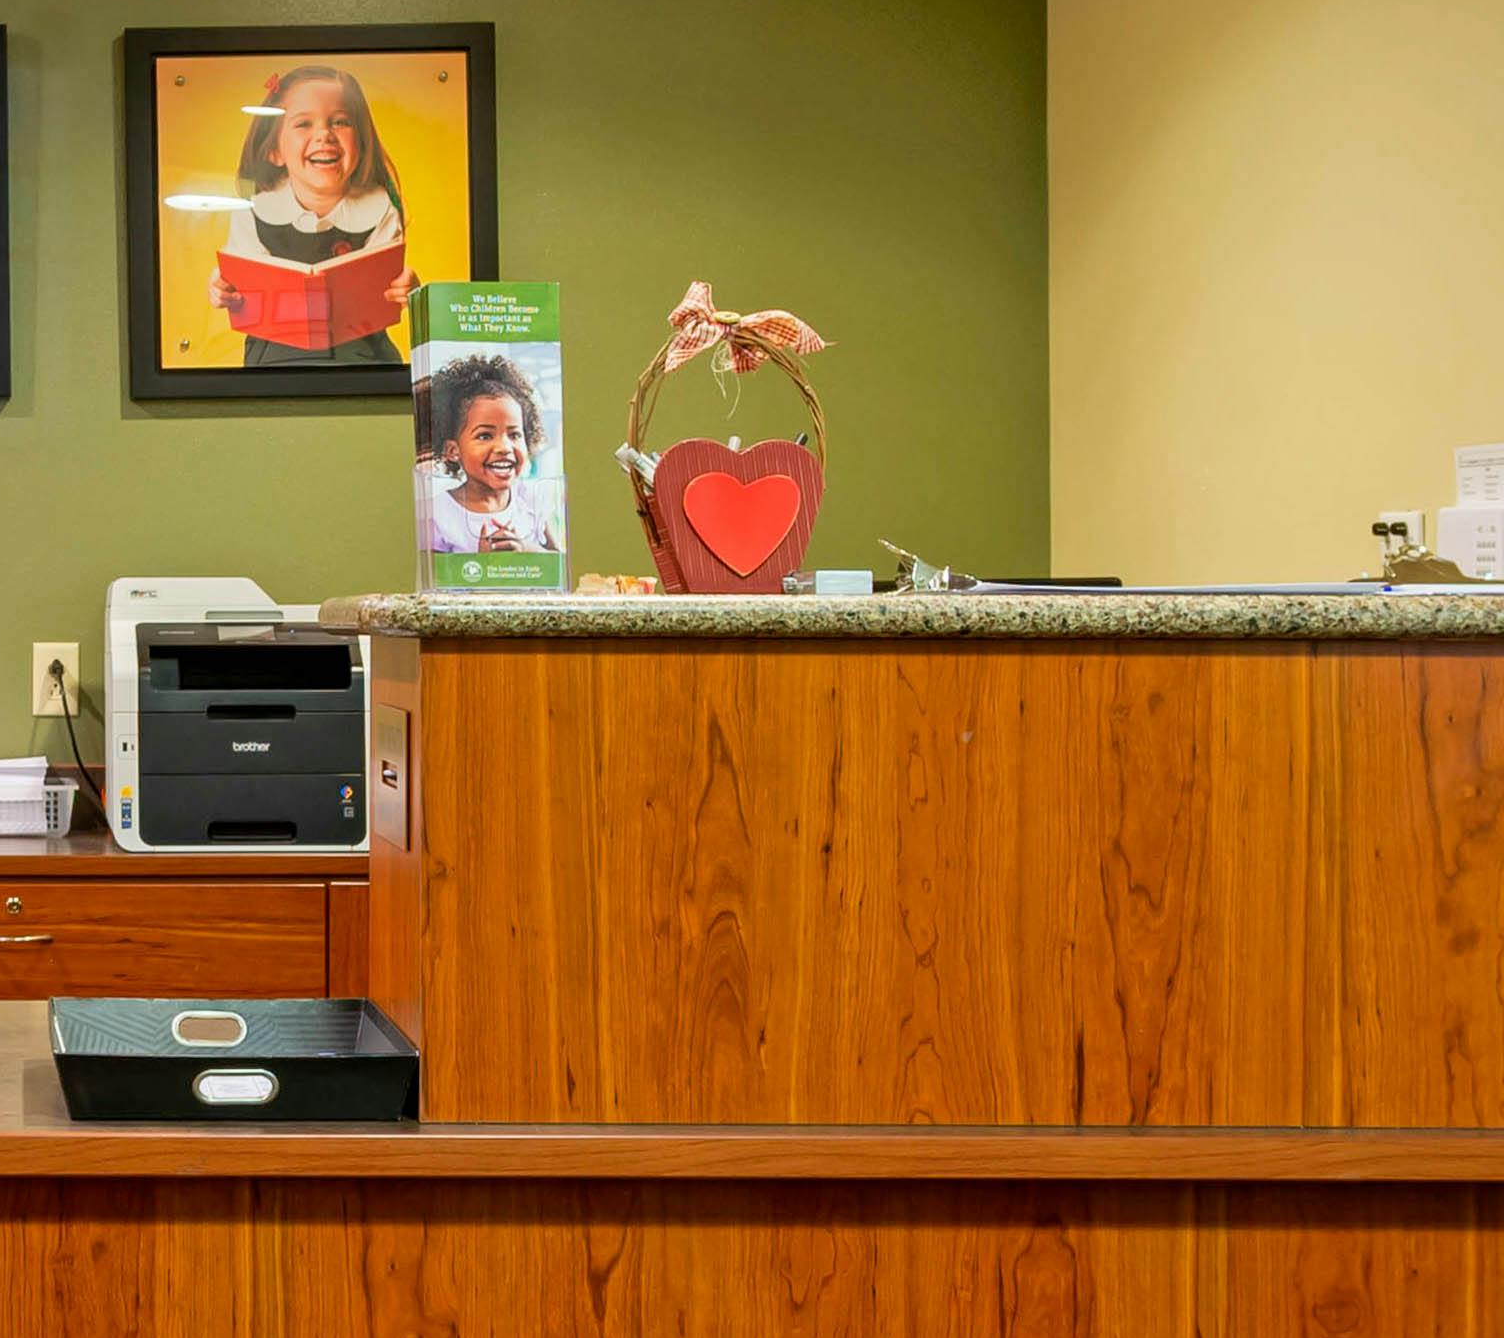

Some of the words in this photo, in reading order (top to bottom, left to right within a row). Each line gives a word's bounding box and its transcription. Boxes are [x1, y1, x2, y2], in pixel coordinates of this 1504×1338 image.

[472, 294, 485, 304] We
[487, 294, 517, 304] Believe
[450, 303, 469, 313] Who
[471, 303, 506, 313] Children
[508, 304, 539, 314] Become
[479, 313, 520, 324] Important
[460, 323, 482, 333] What
[484, 323, 504, 334] They
[232, 741, 271, 753] brother
